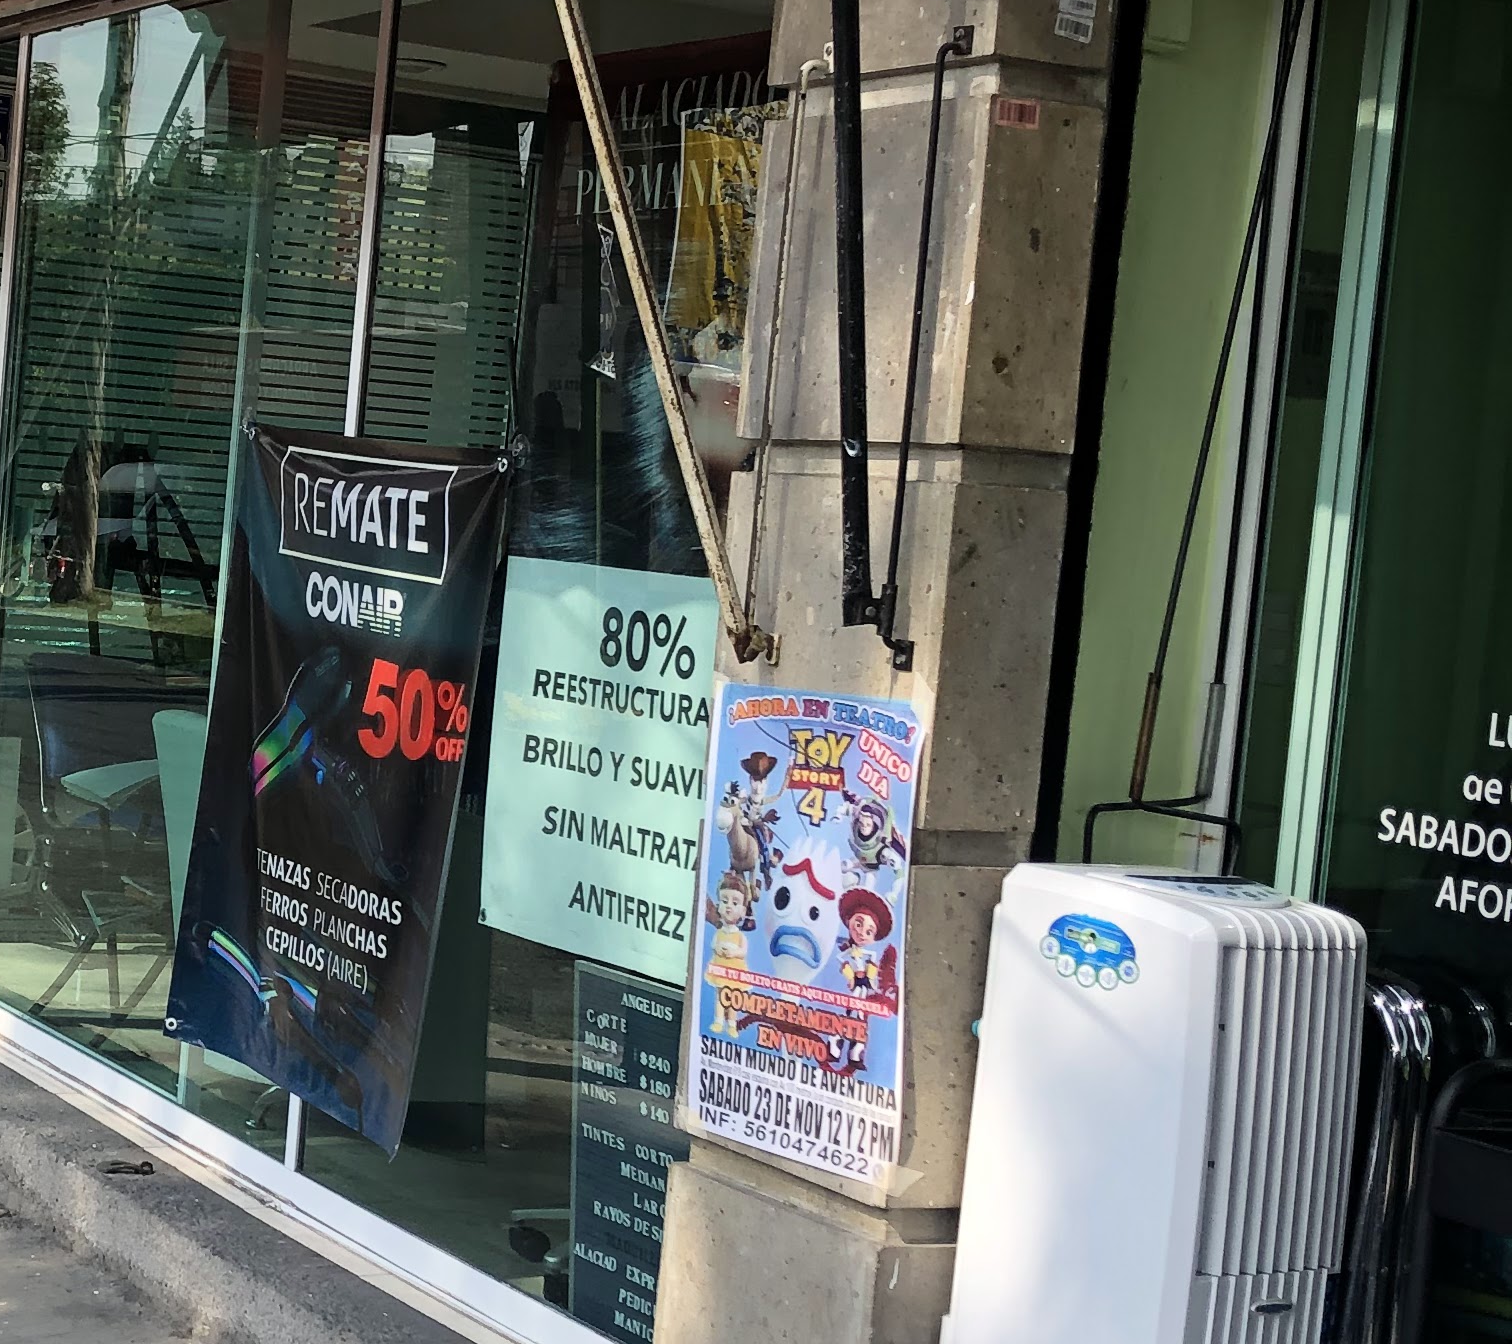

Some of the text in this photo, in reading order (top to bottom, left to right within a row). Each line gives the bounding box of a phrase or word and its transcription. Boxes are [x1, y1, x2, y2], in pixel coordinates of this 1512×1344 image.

[294, 472, 430, 554] REMATE
[305, 571, 405, 637] CONAIR
[600, 606, 696, 680] 80%
[357, 658, 468, 761] 50%
[533, 668, 710, 728] REESTRUCTURA
[802, 698, 830, 718] EN
[435, 737, 466, 762] OFF
[523, 734, 706, 802] BRILLO Y SUAVI
[789, 728, 855, 768] TOY
[858, 729, 912, 782] UNICO
[791, 768, 842, 786] STORY
[857, 760, 890, 800] DIA
[541, 805, 585, 842] SIN
[797, 786, 827, 827] 4
[256, 847, 402, 926] TENAZAS SECADORAS
[568, 881, 687, 942] ANTIFRIZZ
[313, 907, 388, 959] PLANCHAS
[266, 924, 369, 995] CEPILLOS (AIRE)
[586, 1008, 627, 1034] CORTE
[620, 993, 673, 1022] ANGELUS
[719, 985, 868, 1043] COMPLETAMENTE
[757, 1023, 828, 1062] EN VIVO
[581, 1055, 627, 1084] HOMBRE
[700, 1034, 742, 1066] SALON
[745, 1048, 796, 1081] MUNDO
[800, 1062, 817, 1087] DE
[820, 1070, 897, 1111] AVENTURA
[582, 1122, 626, 1151] TINTES
[699, 1068, 751, 1117] SABADO
[754, 1085, 772, 1123] 23
[774, 1091, 792, 1130] DE
[794, 1098, 824, 1140] NOV
[827, 1108, 843, 1146] 12
[846, 1114, 856, 1150] Y
[857, 1117, 866, 1154] 2
[869, 1121, 895, 1163] PM
[699, 1104, 869, 1175] INF: 5610474622
[593, 1200, 631, 1228] RAYOS
